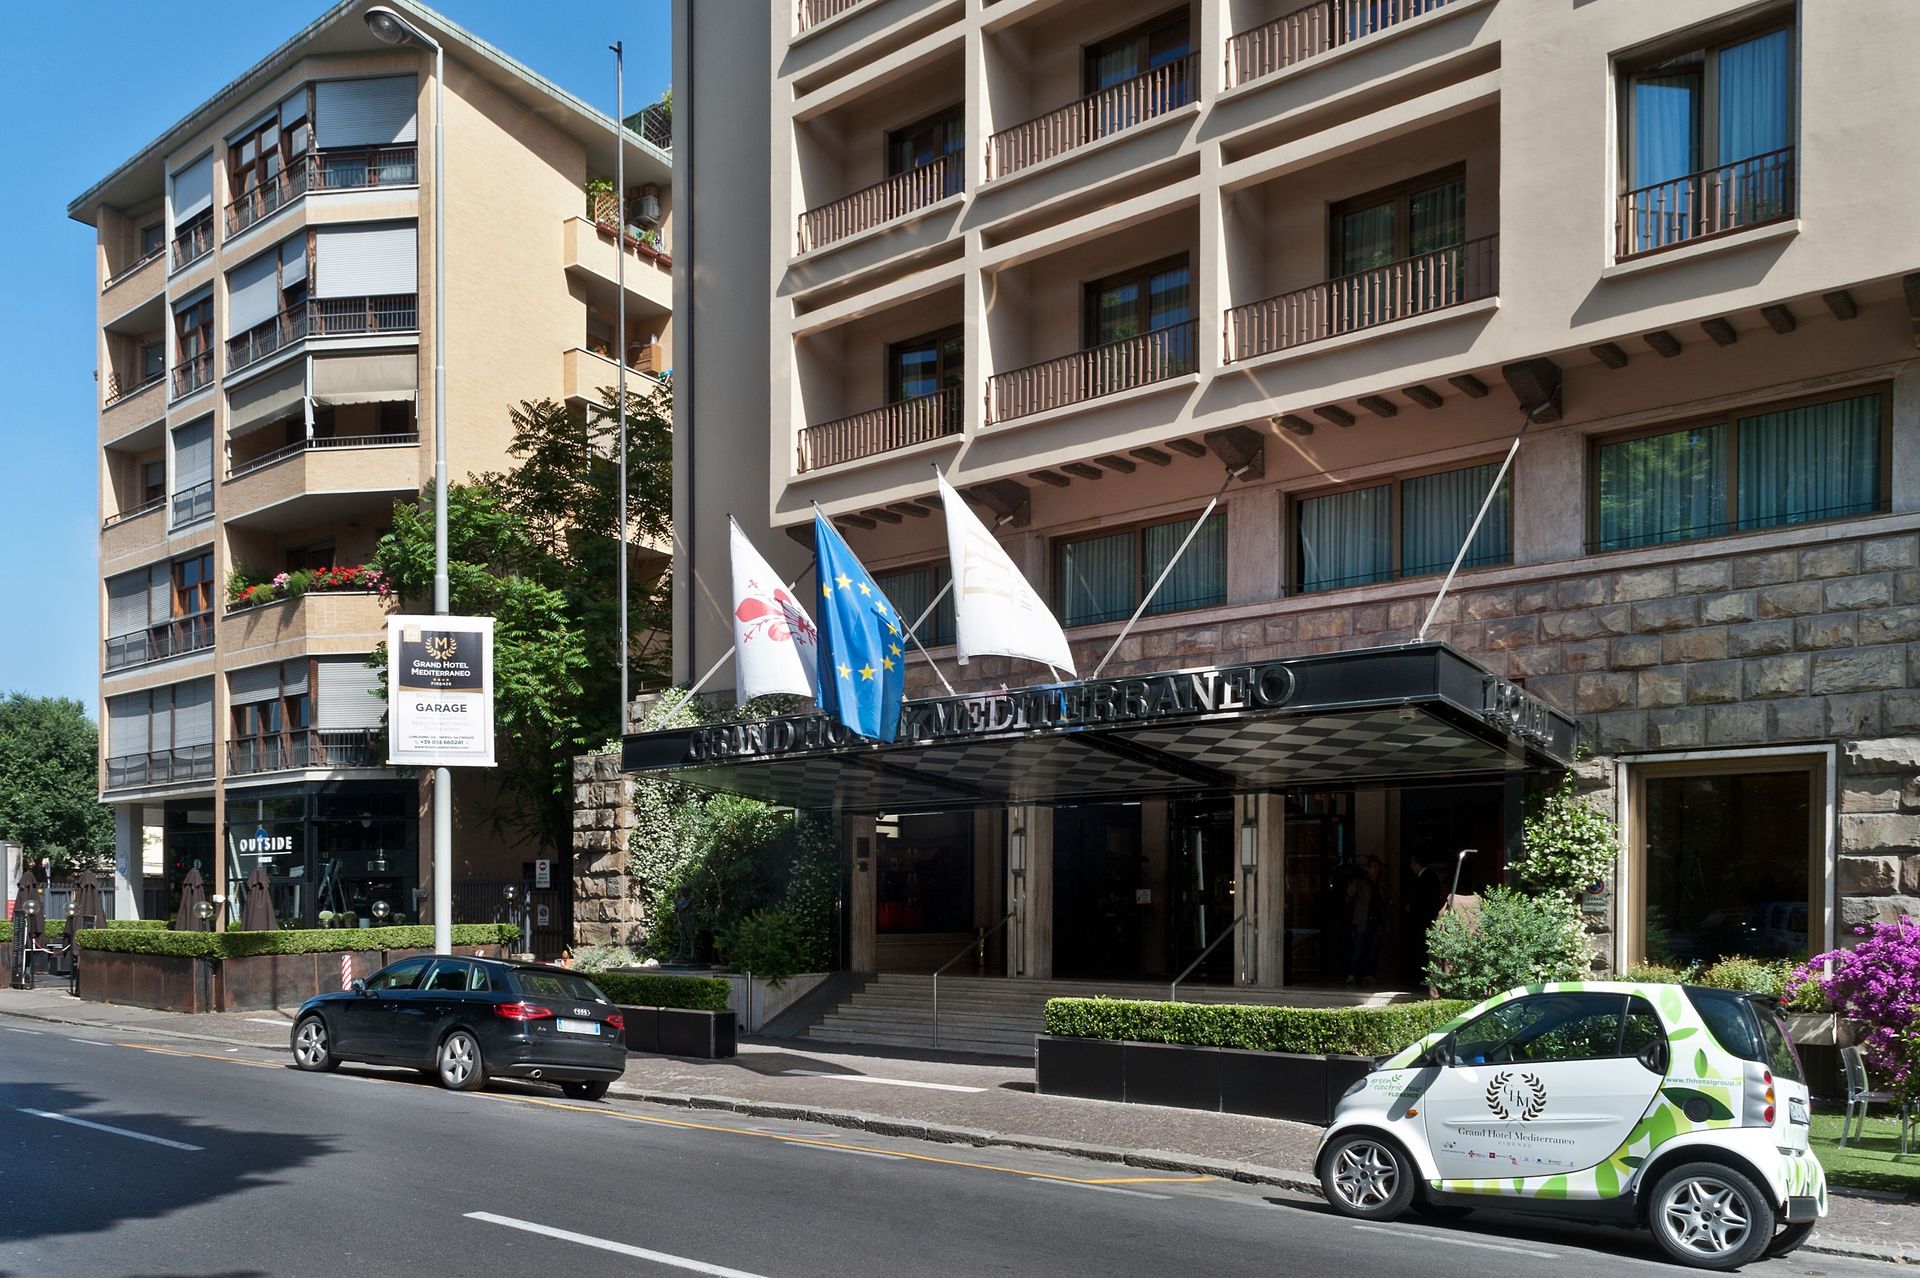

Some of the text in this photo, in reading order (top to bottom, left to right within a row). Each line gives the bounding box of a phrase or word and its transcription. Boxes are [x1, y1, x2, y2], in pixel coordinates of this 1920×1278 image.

[435, 637, 447, 649] M
[413, 659, 469, 669] GRAND HOTEL
[411, 667, 471, 677] MEDITERRANEO
[415, 703, 467, 713] GARAGE
[689, 720, 796, 762] GRAND
[932, 664, 1296, 739] MEDITERRANEO
[239, 836, 292, 852] OUTSIDE
[1458, 1127, 1575, 1145] Grand Hotel Mediterraneo
